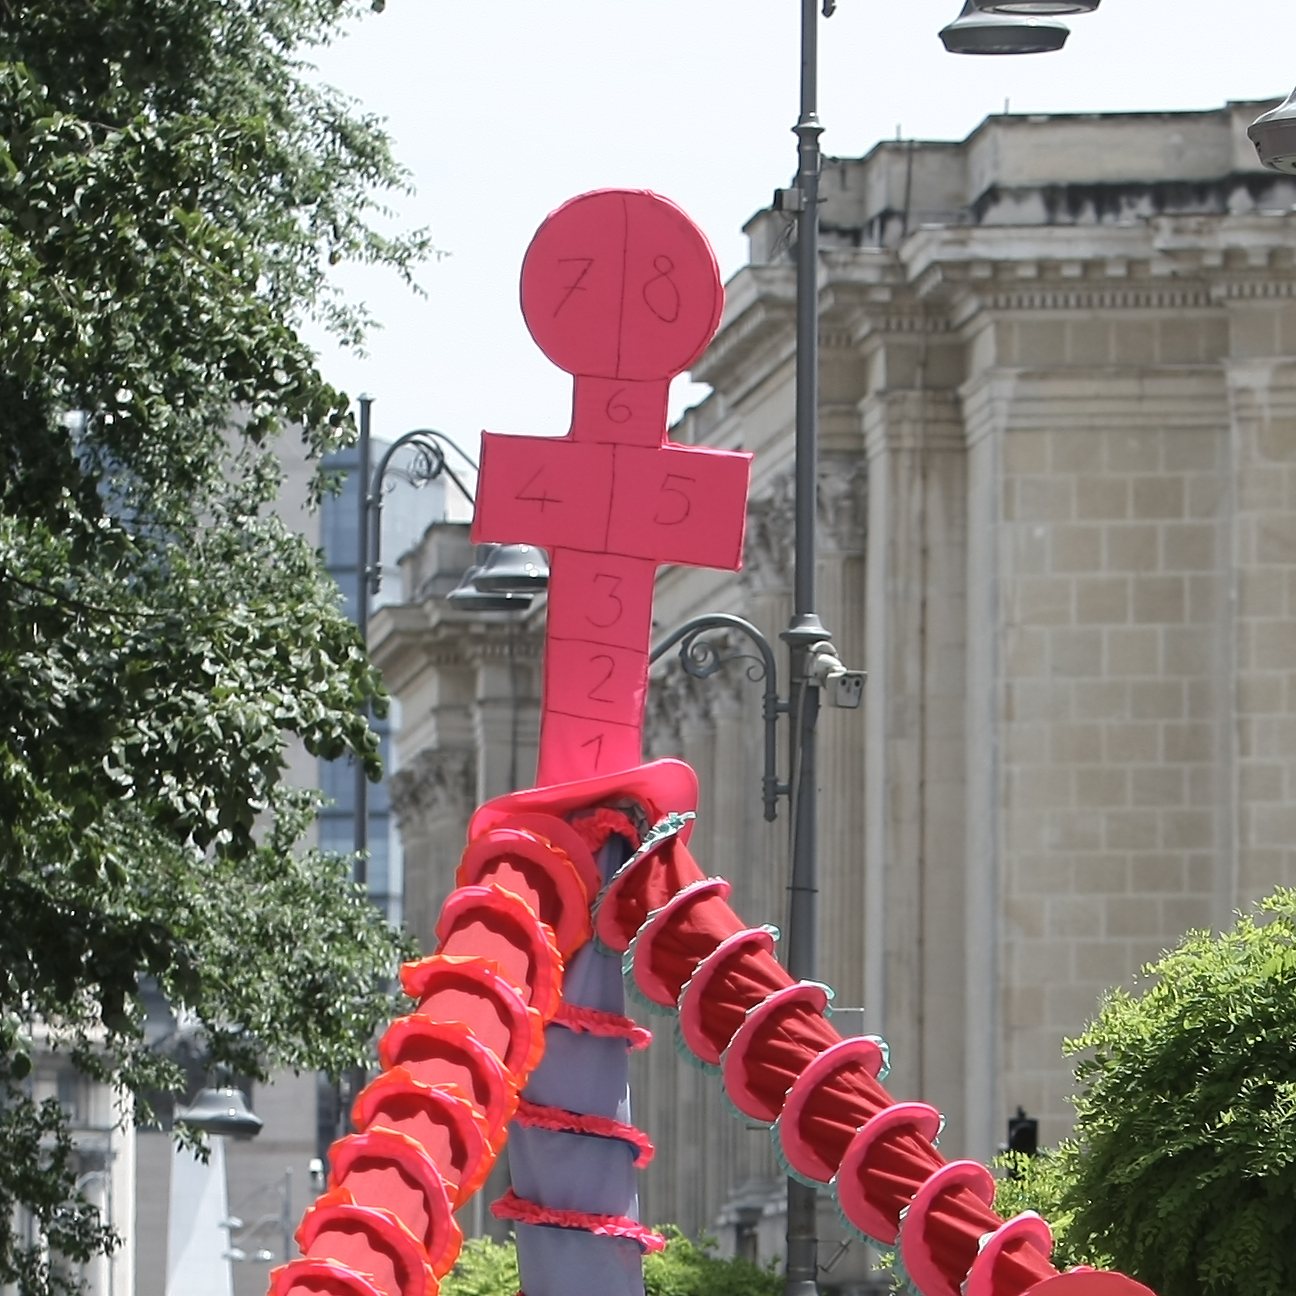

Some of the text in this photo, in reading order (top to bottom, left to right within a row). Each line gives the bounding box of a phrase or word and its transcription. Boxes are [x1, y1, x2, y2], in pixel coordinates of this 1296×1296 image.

[553, 258, 595, 318] 7
[642, 254, 680, 324] 8
[605, 388, 633, 424] 6
[514, 466, 563, 513] 4
[653, 473, 696, 526] 5
[585, 573, 624, 628] 3
[586, 654, 616, 704] 2
[579, 733, 605, 772] 1
